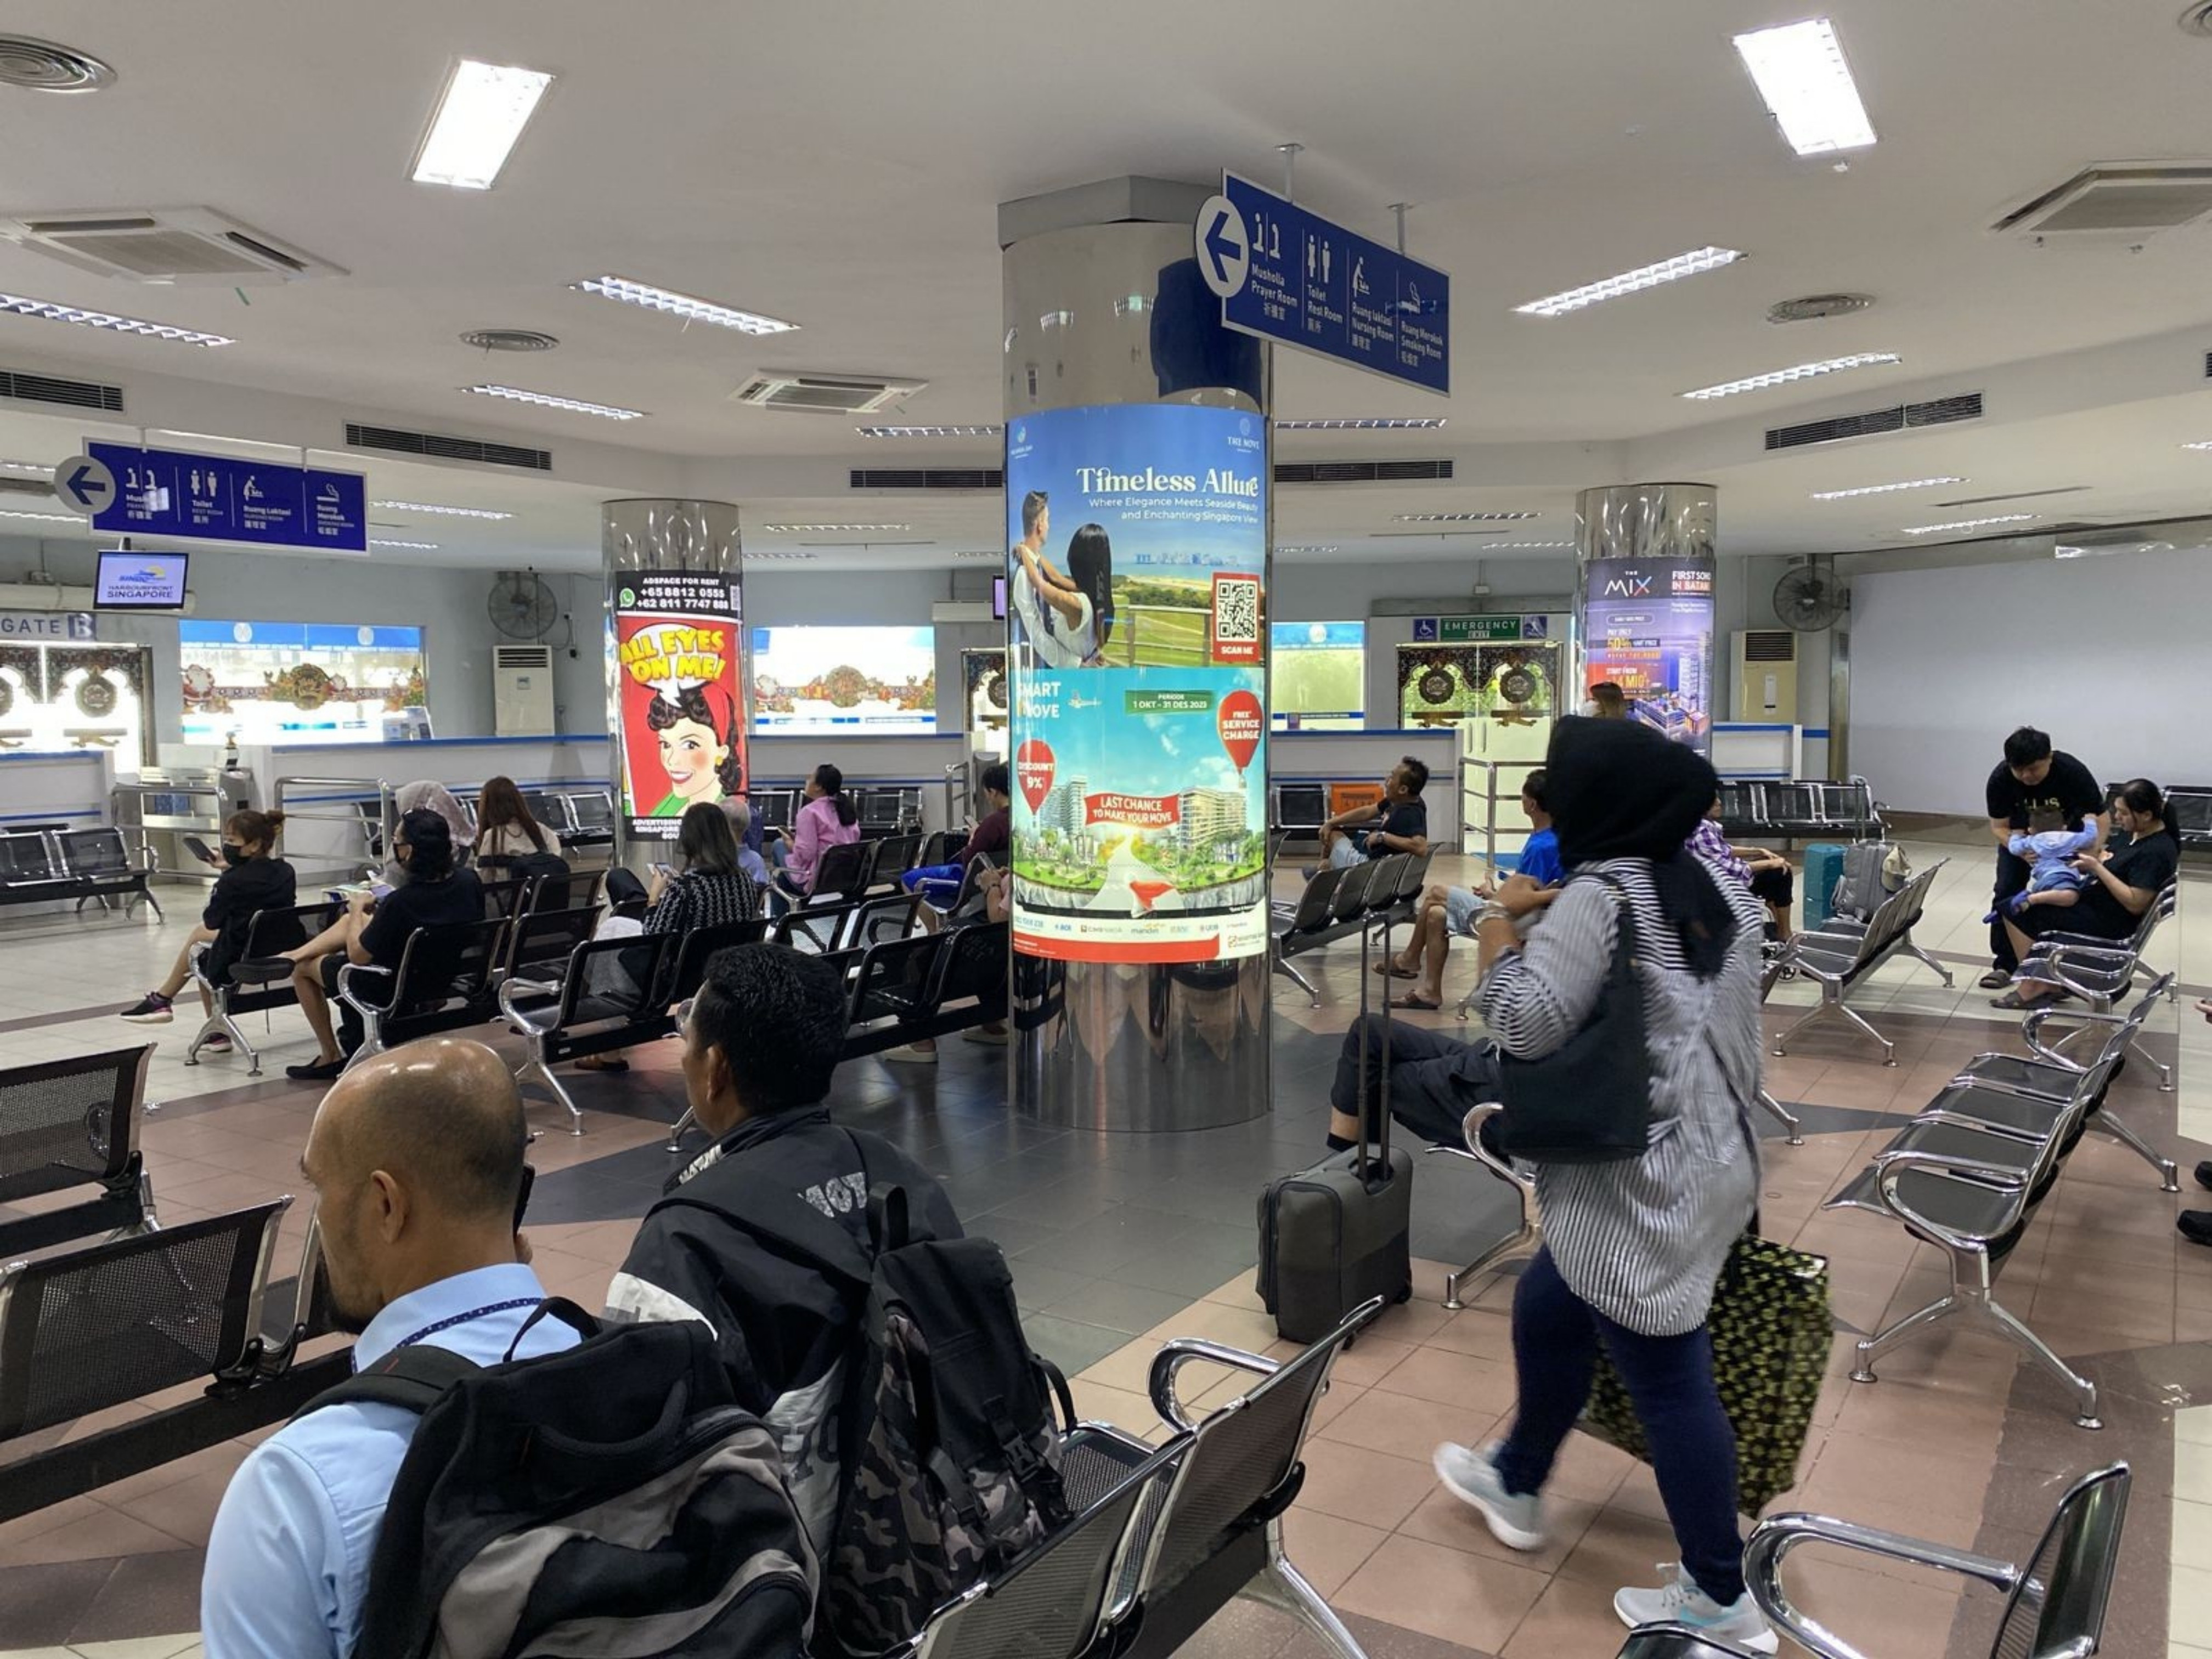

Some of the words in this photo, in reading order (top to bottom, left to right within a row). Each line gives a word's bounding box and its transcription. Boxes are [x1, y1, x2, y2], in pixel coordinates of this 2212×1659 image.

[1251, 280, 1277, 300] Prayer
[1277, 290, 1297, 307] Room
[1307, 284, 1326, 301] Toilet
[1308, 301, 1323, 317] Rest
[1324, 306, 1343, 324] Room
[1377, 326, 1394, 342] Room
[1426, 344, 1442, 360] Room
[1076, 466, 1197, 493] Timeless
[1201, 468, 1259, 497] Allure
[1089, 498, 1122, 507] Where
[1125, 497, 1172, 509] Elegance
[1175, 498, 1204, 507] Meets
[1205, 499, 1235, 509] Seaside
[1121, 511, 1141, 520] and
[1144, 510, 1201, 522] Enchanting
[1203, 512, 1242, 523] Singapore
[1672, 571, 1695, 580] FIRST
[641, 587, 663, 596] +65
[664, 587, 695, 597] 8812
[699, 588, 725, 597] 0555
[1604, 576, 1653, 597] MIX
[637, 599, 657, 608] +62
[659, 599, 681, 608] 811
[684, 599, 711, 608] 7747
[1, 618, 60, 634] GATE
[74, 612, 93, 638] B
[1444, 620, 1516, 630] EMERGENCY
[620, 635, 657, 664] ALL
[661, 629, 725, 654] EYES
[1221, 646, 1242, 654] SCAN
[631, 656, 671, 683] ON
[676, 656, 726, 680] ME!
[1016, 681, 1062, 697] SMART
[1017, 703, 1060, 719] MOVE
[1139, 701, 1157, 709] OKT
[1163, 701, 1172, 709] 31
[1172, 701, 1188, 709] DES
[1223, 719, 1260, 729] SERVICE
[1223, 730, 1260, 741] CHARGE
[1018, 762, 1054, 771] DISCOUNT
[1027, 776, 1043, 788] 9%
[1101, 797, 1123, 808] LAST
[1124, 798, 1163, 811] CHANCE
[1093, 809, 1103, 817] TO
[1104, 809, 1125, 820] MAKE
[1126, 812, 1149, 822] YOUR
[1150, 811, 1172, 823] MOVE
